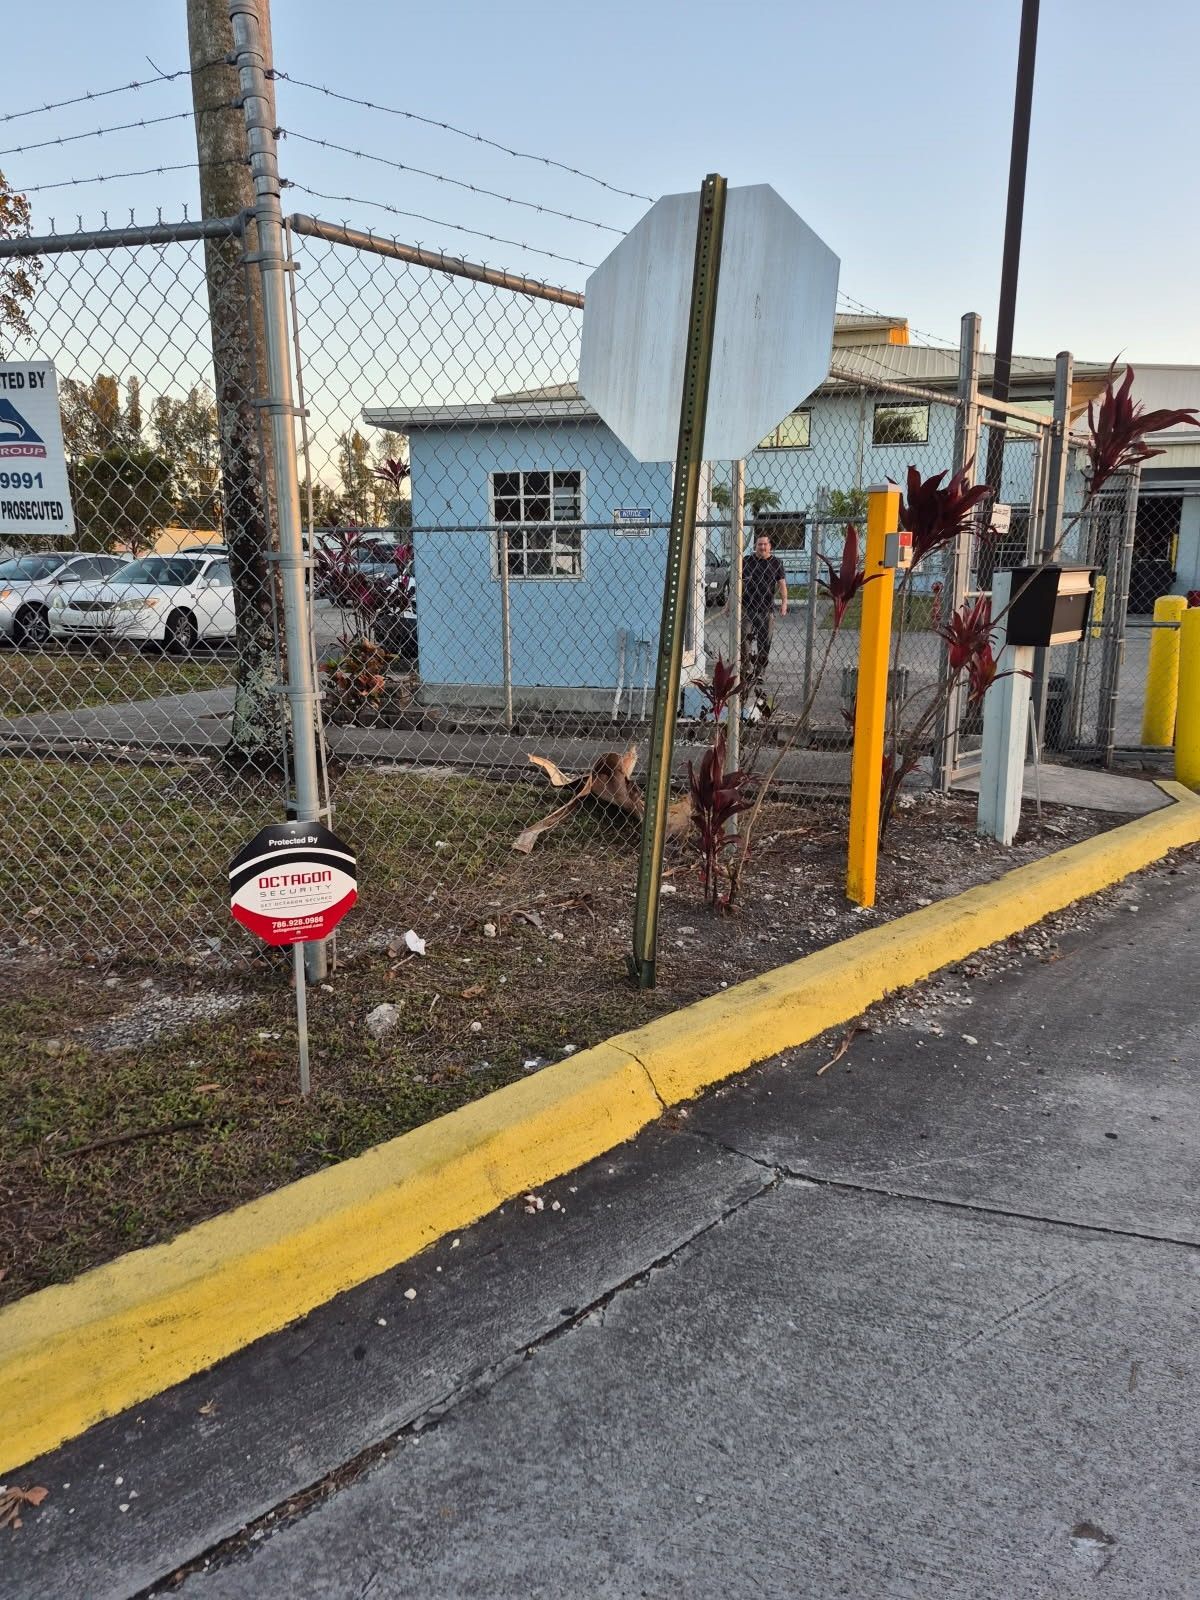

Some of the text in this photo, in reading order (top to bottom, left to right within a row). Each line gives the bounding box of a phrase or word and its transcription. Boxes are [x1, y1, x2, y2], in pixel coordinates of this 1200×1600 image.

[29, 371, 45, 388] BY
[0, 472, 43, 489] 9991
[1, 500, 64, 521] PROSECUTED
[269, 837, 306, 846] Protected
[259, 871, 331, 888] OCTAGON
[260, 884, 331, 897] SECURITY
[272, 916, 323, 928] 786.928.0986
